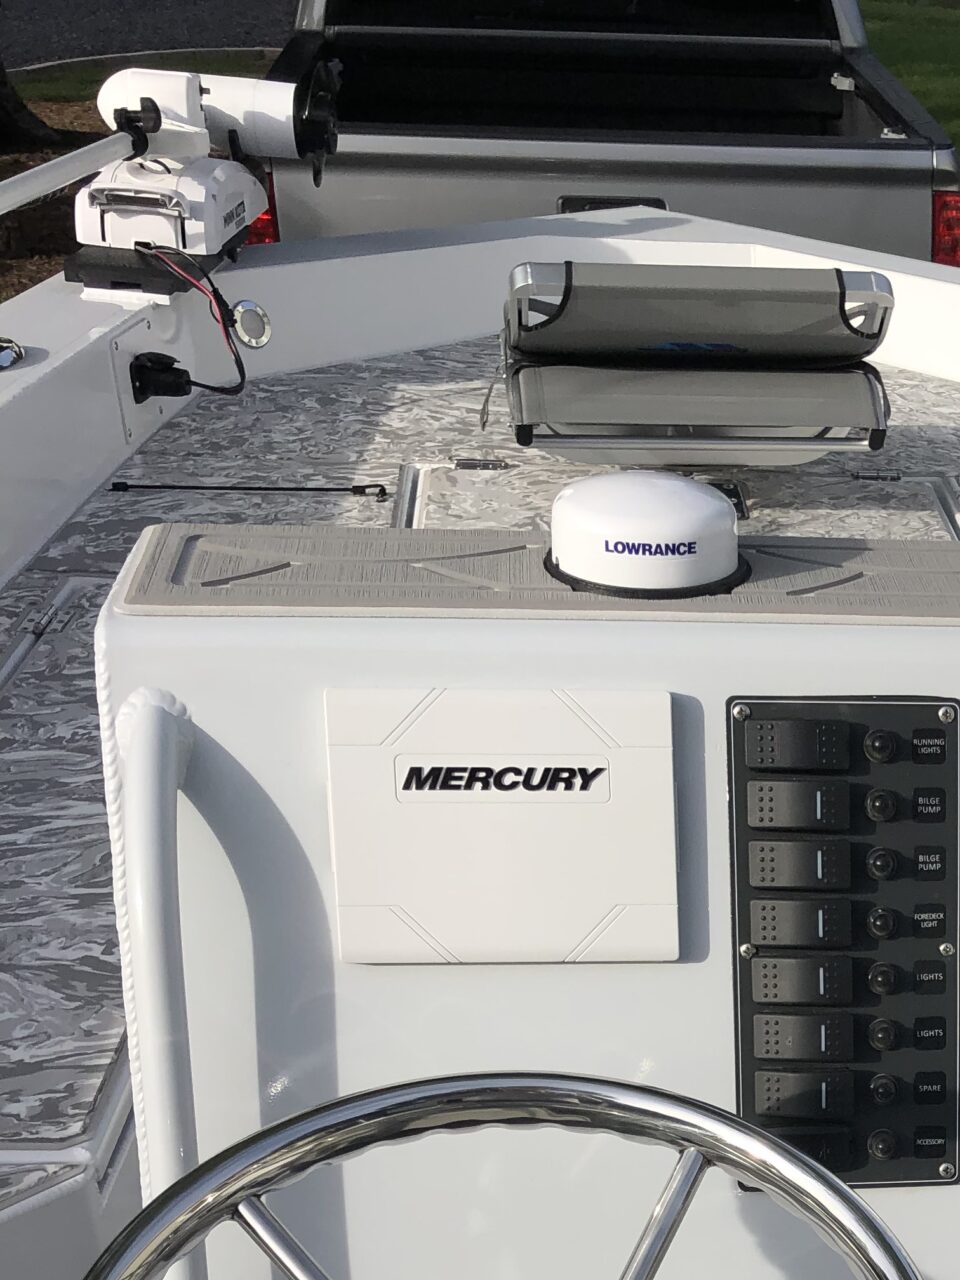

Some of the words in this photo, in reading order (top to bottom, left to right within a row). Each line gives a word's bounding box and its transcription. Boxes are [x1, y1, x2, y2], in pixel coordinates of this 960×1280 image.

[605, 540, 697, 556] LOWRANCE
[913, 738, 945, 746] RUNNING
[402, 766, 607, 791] MERCURY
[918, 797, 941, 805] BILGE
[917, 806, 941, 814] PUMP
[918, 854, 941, 862] BILGE
[918, 863, 942, 871] PUMP
[916, 972, 944, 981] LIGHTS
[916, 1028, 944, 1037] LIGHTS
